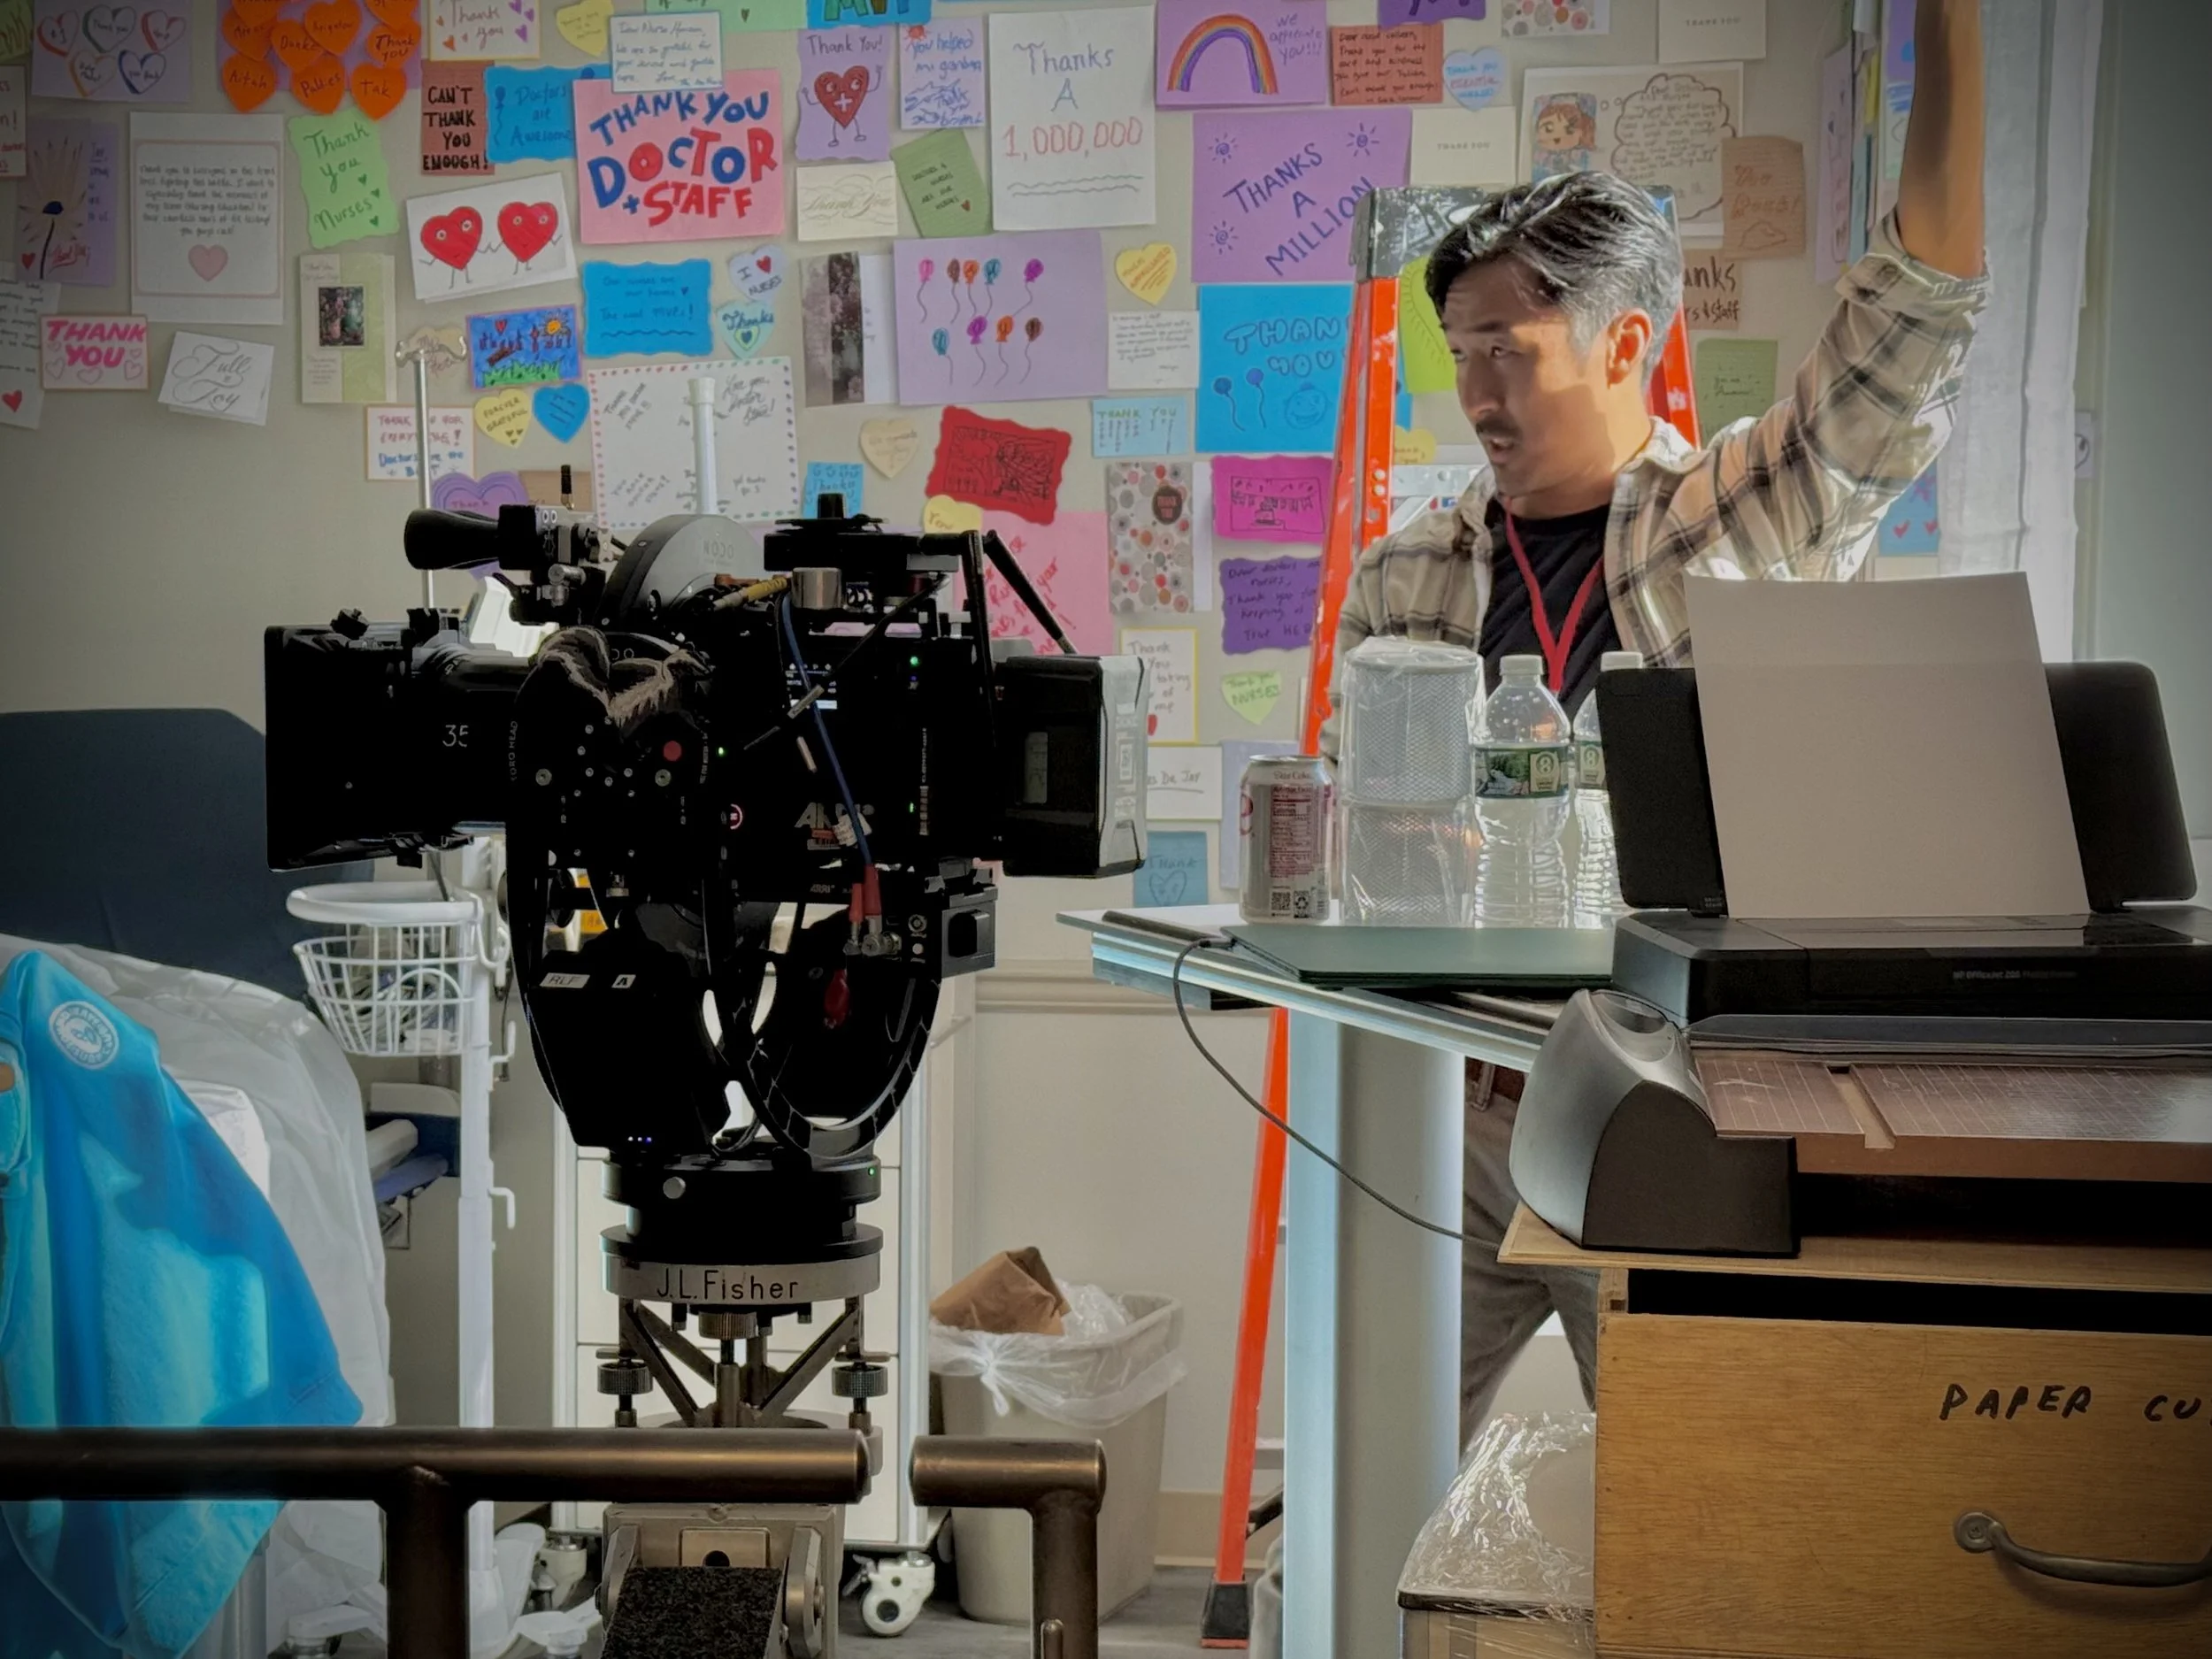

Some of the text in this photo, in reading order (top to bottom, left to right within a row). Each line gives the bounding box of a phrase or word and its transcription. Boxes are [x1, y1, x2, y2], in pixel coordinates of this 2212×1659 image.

[806, 33, 853, 57] Thank
[1013, 40, 1115, 77] Thanks
[427, 85, 474, 105] CAN'T
[1050, 78, 1079, 112] A
[422, 109, 477, 128] THANK
[588, 90, 770, 148] THANK YOU
[303, 121, 370, 158] Thank
[1003, 117, 1143, 162] 1,000,000
[422, 153, 489, 171] ENOUGH!
[587, 126, 779, 210] DOCTOR
[1223, 142, 1324, 214] THANKS
[642, 180, 753, 228] STAFF
[1291, 190, 1317, 219] A
[749, 275, 782, 296] NURSES
[1683, 257, 1737, 291] anks
[46, 319, 146, 343] THANK
[722, 309, 775, 331] Thanks
[65, 343, 126, 369] YOU
[1096, 406, 1178, 419] THANK YOU
[1226, 592, 1264, 605] Thank
[1128, 641, 1171, 653] Thank
[1939, 1383, 2212, 1427] PAPER CU
